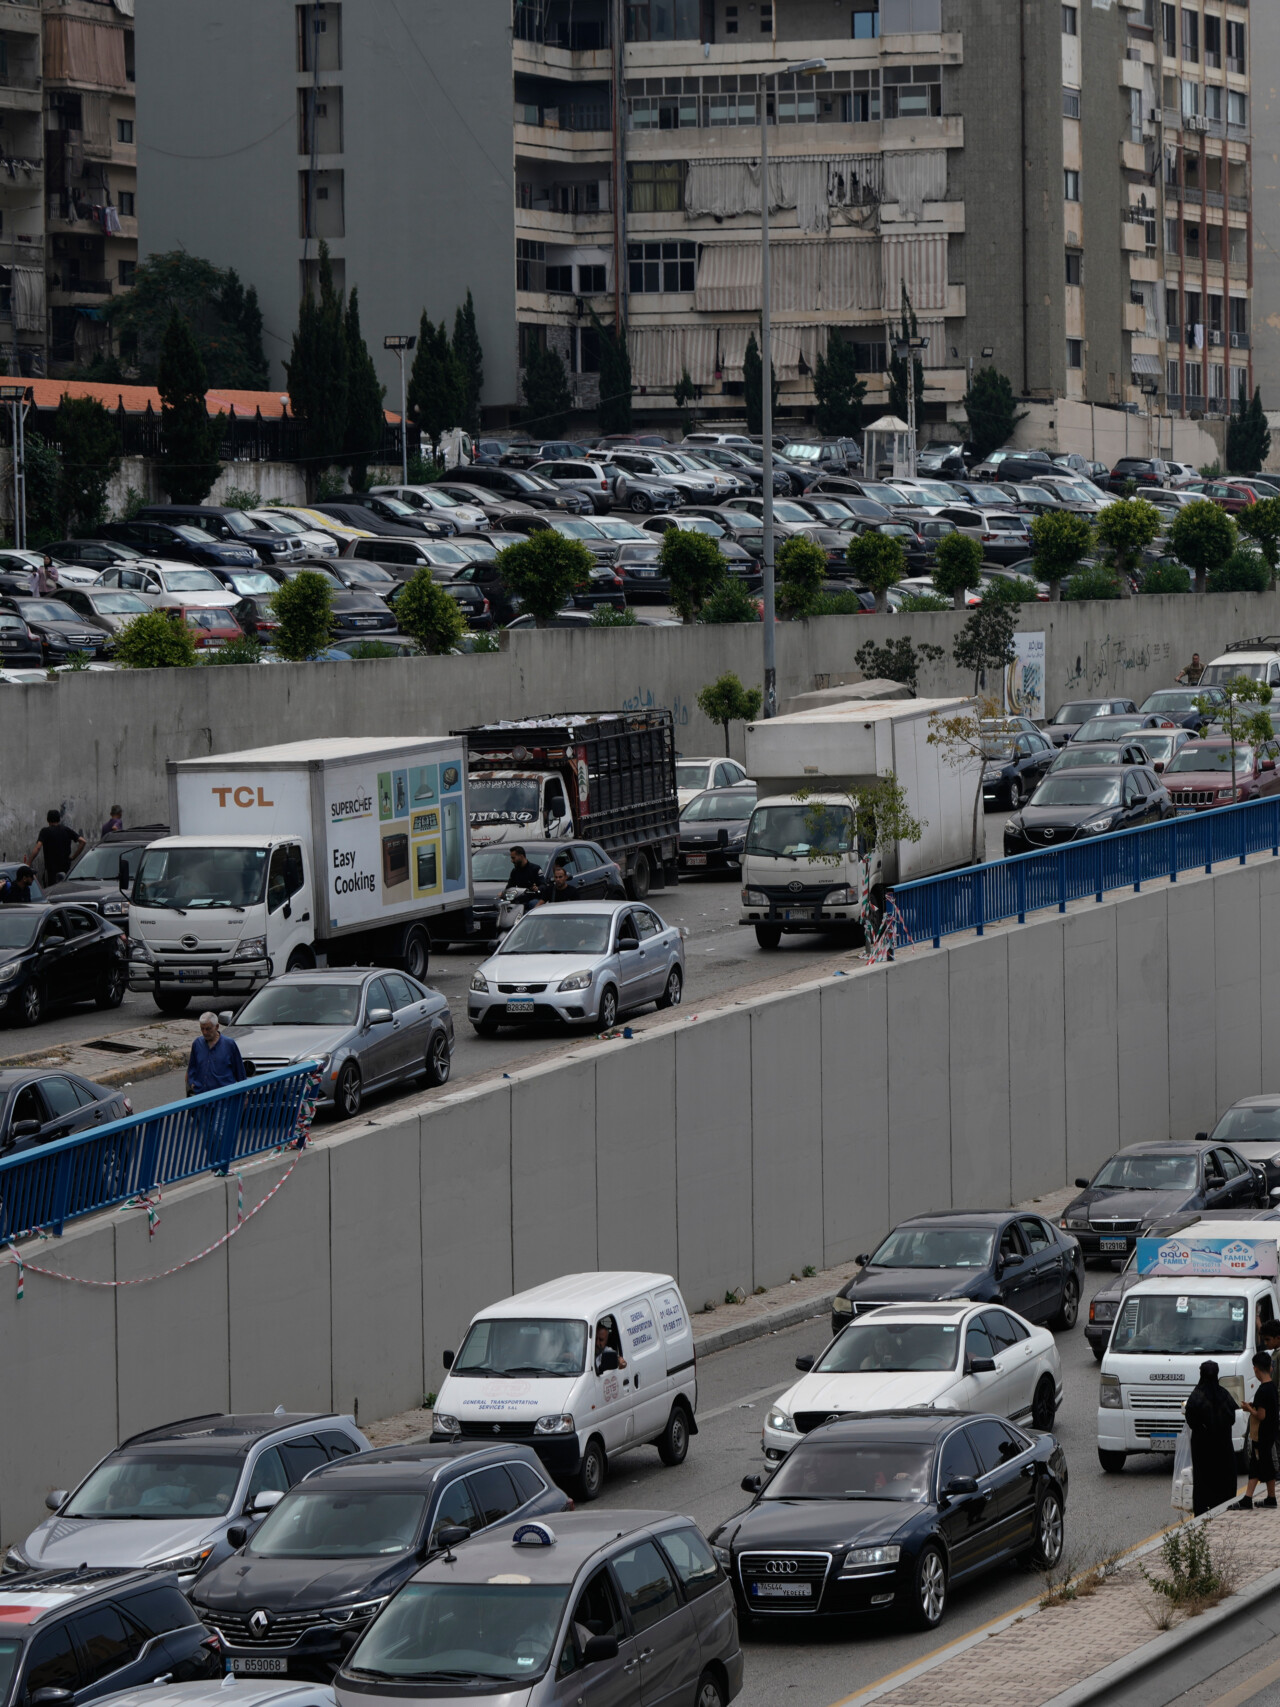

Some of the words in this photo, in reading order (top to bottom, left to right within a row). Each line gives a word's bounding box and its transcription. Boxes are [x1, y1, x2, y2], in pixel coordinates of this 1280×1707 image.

[212, 786, 274, 808] TCL
[331, 796, 373, 817] SUPERCHEF
[333, 848, 356, 869] Easy
[334, 871, 376, 896] Cooking
[1100, 1242, 1126, 1250] B129182
[1160, 1251, 1189, 1262] aqua
[1149, 1373, 1186, 1381] SUZUKI
[233, 1659, 240, 1670] G
[245, 1659, 281, 1671] 659068
